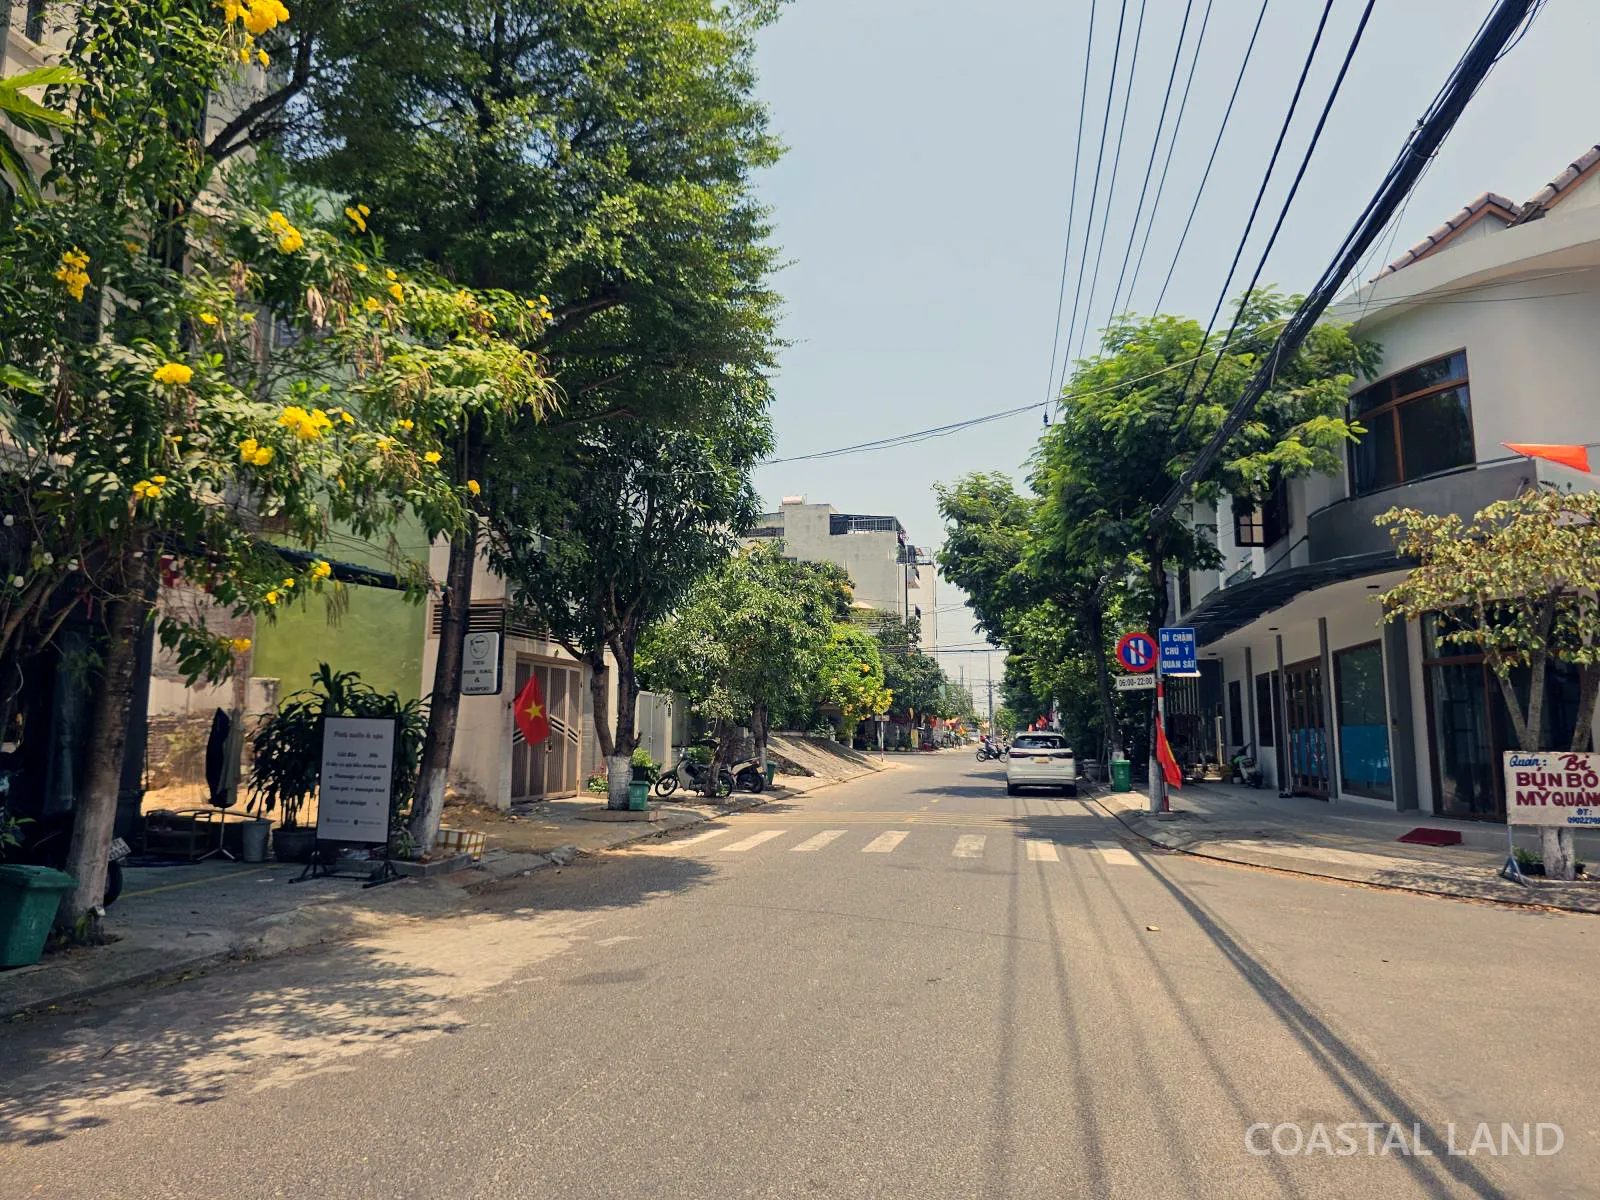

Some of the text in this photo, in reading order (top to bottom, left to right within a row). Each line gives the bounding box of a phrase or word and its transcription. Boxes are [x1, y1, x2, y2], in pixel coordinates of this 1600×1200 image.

[1119, 677, 1153, 687] 06:00-22:00
[1515, 767, 1599, 788] BÚN BÒ
